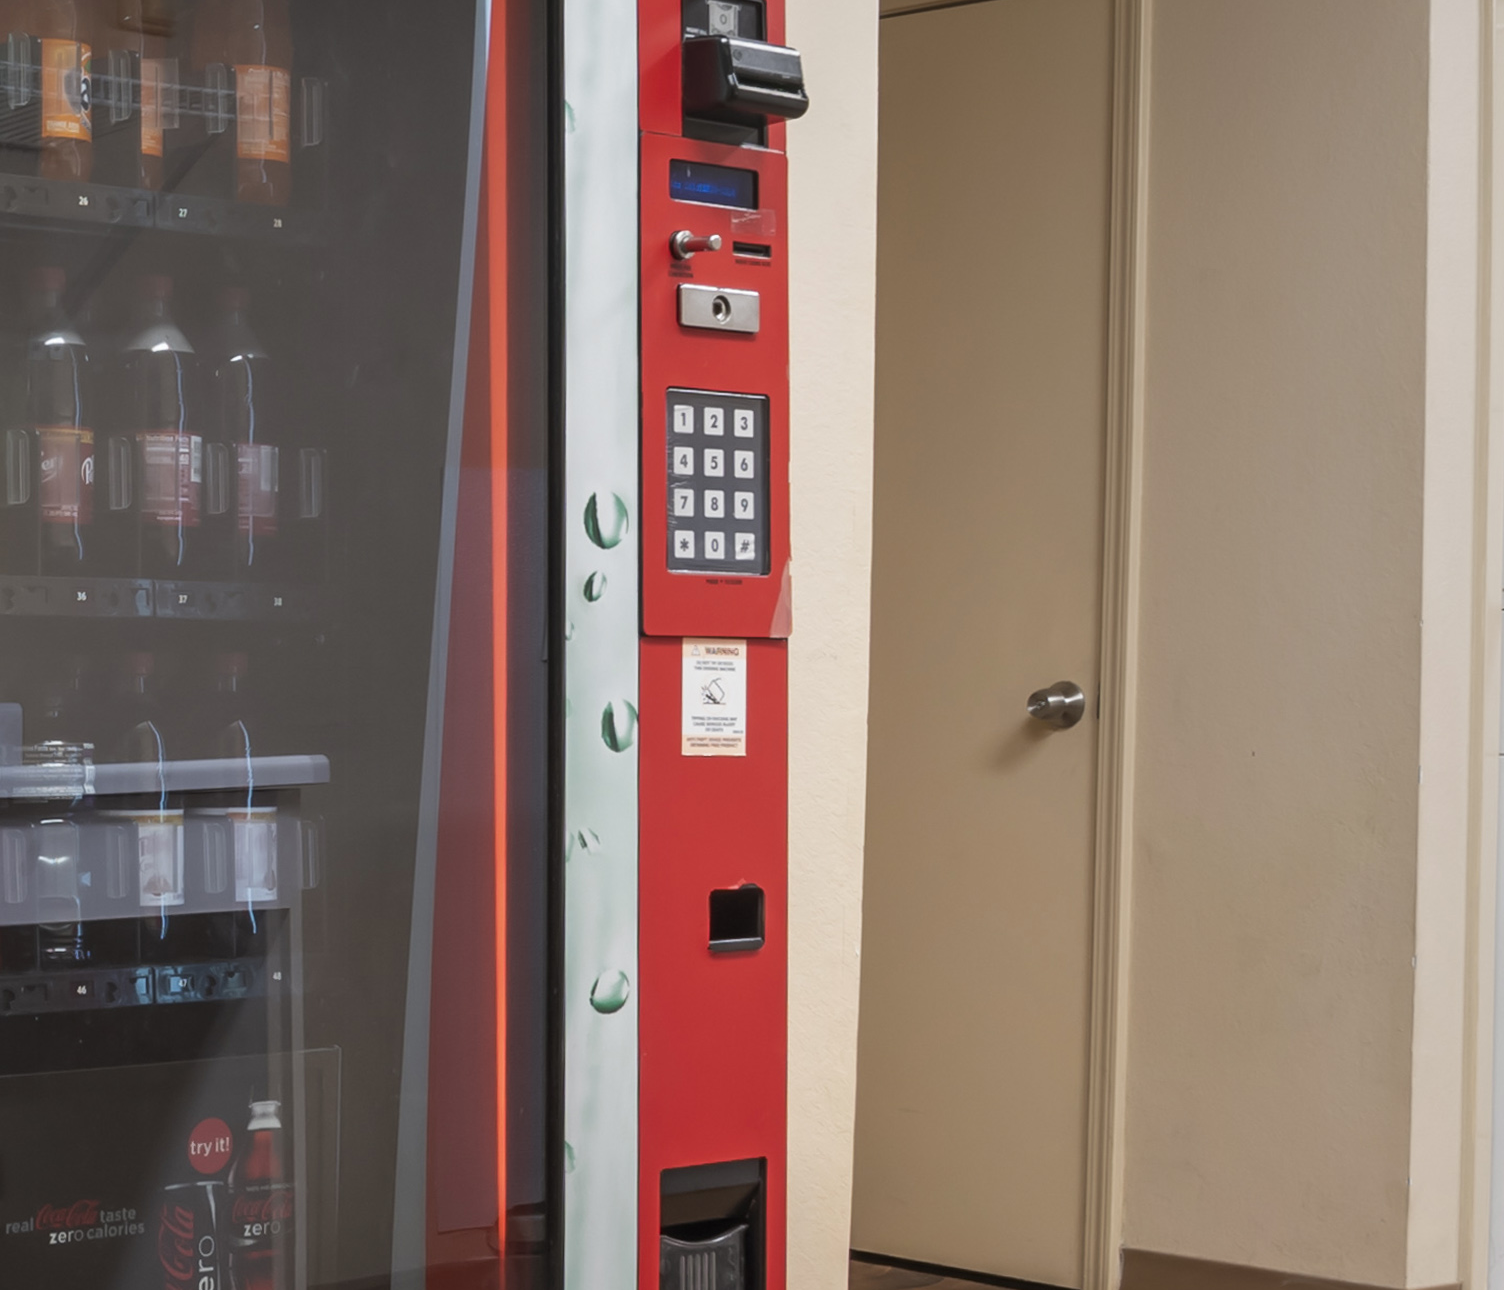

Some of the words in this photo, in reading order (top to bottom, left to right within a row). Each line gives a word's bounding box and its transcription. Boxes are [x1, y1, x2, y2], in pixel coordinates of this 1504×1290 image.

[681, 412, 687, 427] 1
[710, 414, 719, 429] 2
[740, 416, 749, 430] 3
[679, 454, 689, 469] 4
[710, 456, 719, 470] 5
[740, 457, 749, 472] 6
[680, 495, 689, 510] 7
[710, 497, 719, 511] 8
[740, 498, 749, 513] 9
[711, 539, 719, 552] 0
[76, 591, 88, 602] 36
[704, 646, 740, 657] WARNING
[272, 971, 283, 982] 48
[190, 1139, 213, 1157] try
[215, 1136, 230, 1153] it!
[5, 1216, 34, 1235] real
[100, 1207, 137, 1224] taste
[49, 1227, 85, 1245] zero
[86, 1220, 146, 1241] calories
[243, 1220, 282, 1238] zero
